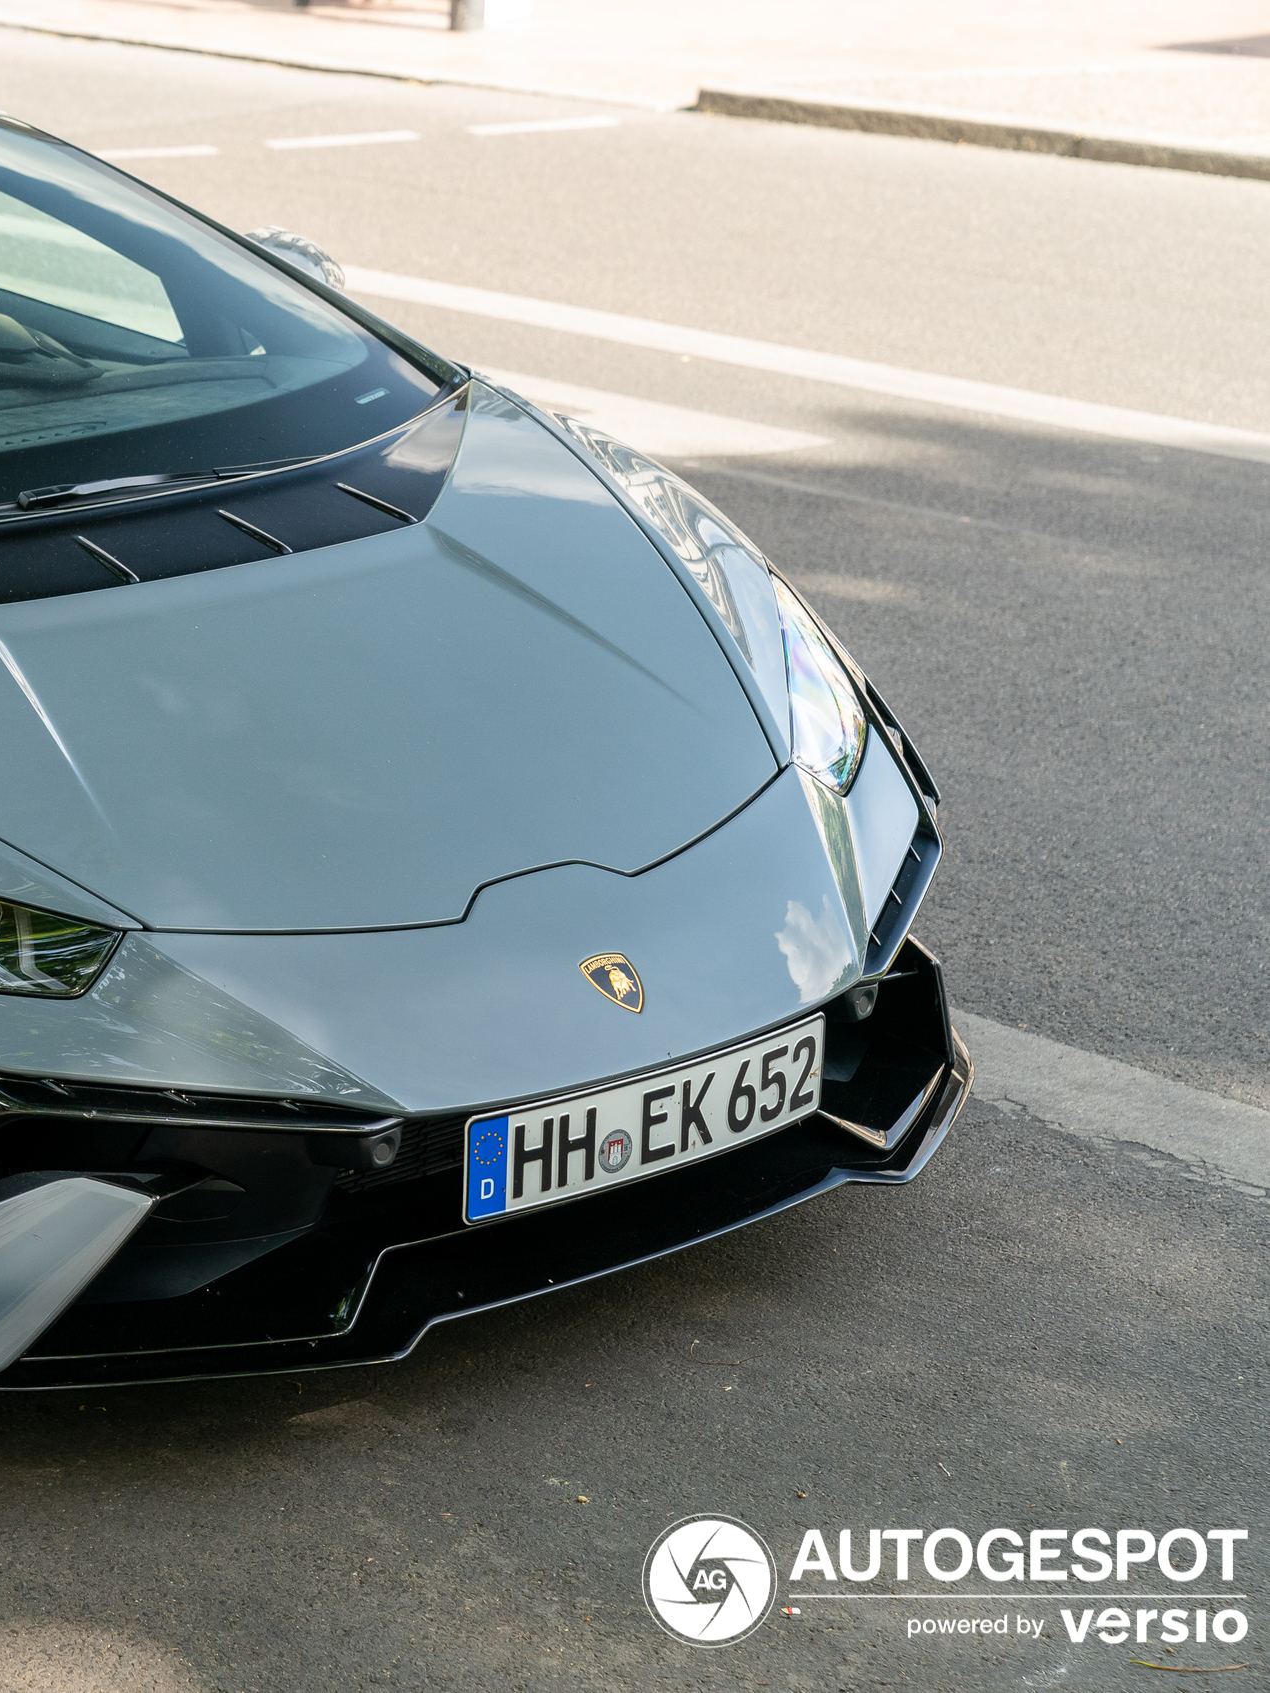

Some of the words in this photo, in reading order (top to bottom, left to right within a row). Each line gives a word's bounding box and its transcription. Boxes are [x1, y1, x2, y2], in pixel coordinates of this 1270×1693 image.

[584, 956, 626, 974] LAMBORGHINI
[480, 1178, 495, 1200] D
[512, 1107, 597, 1199] HH
[641, 1072, 715, 1164] EK
[728, 1036, 816, 1133] 652
